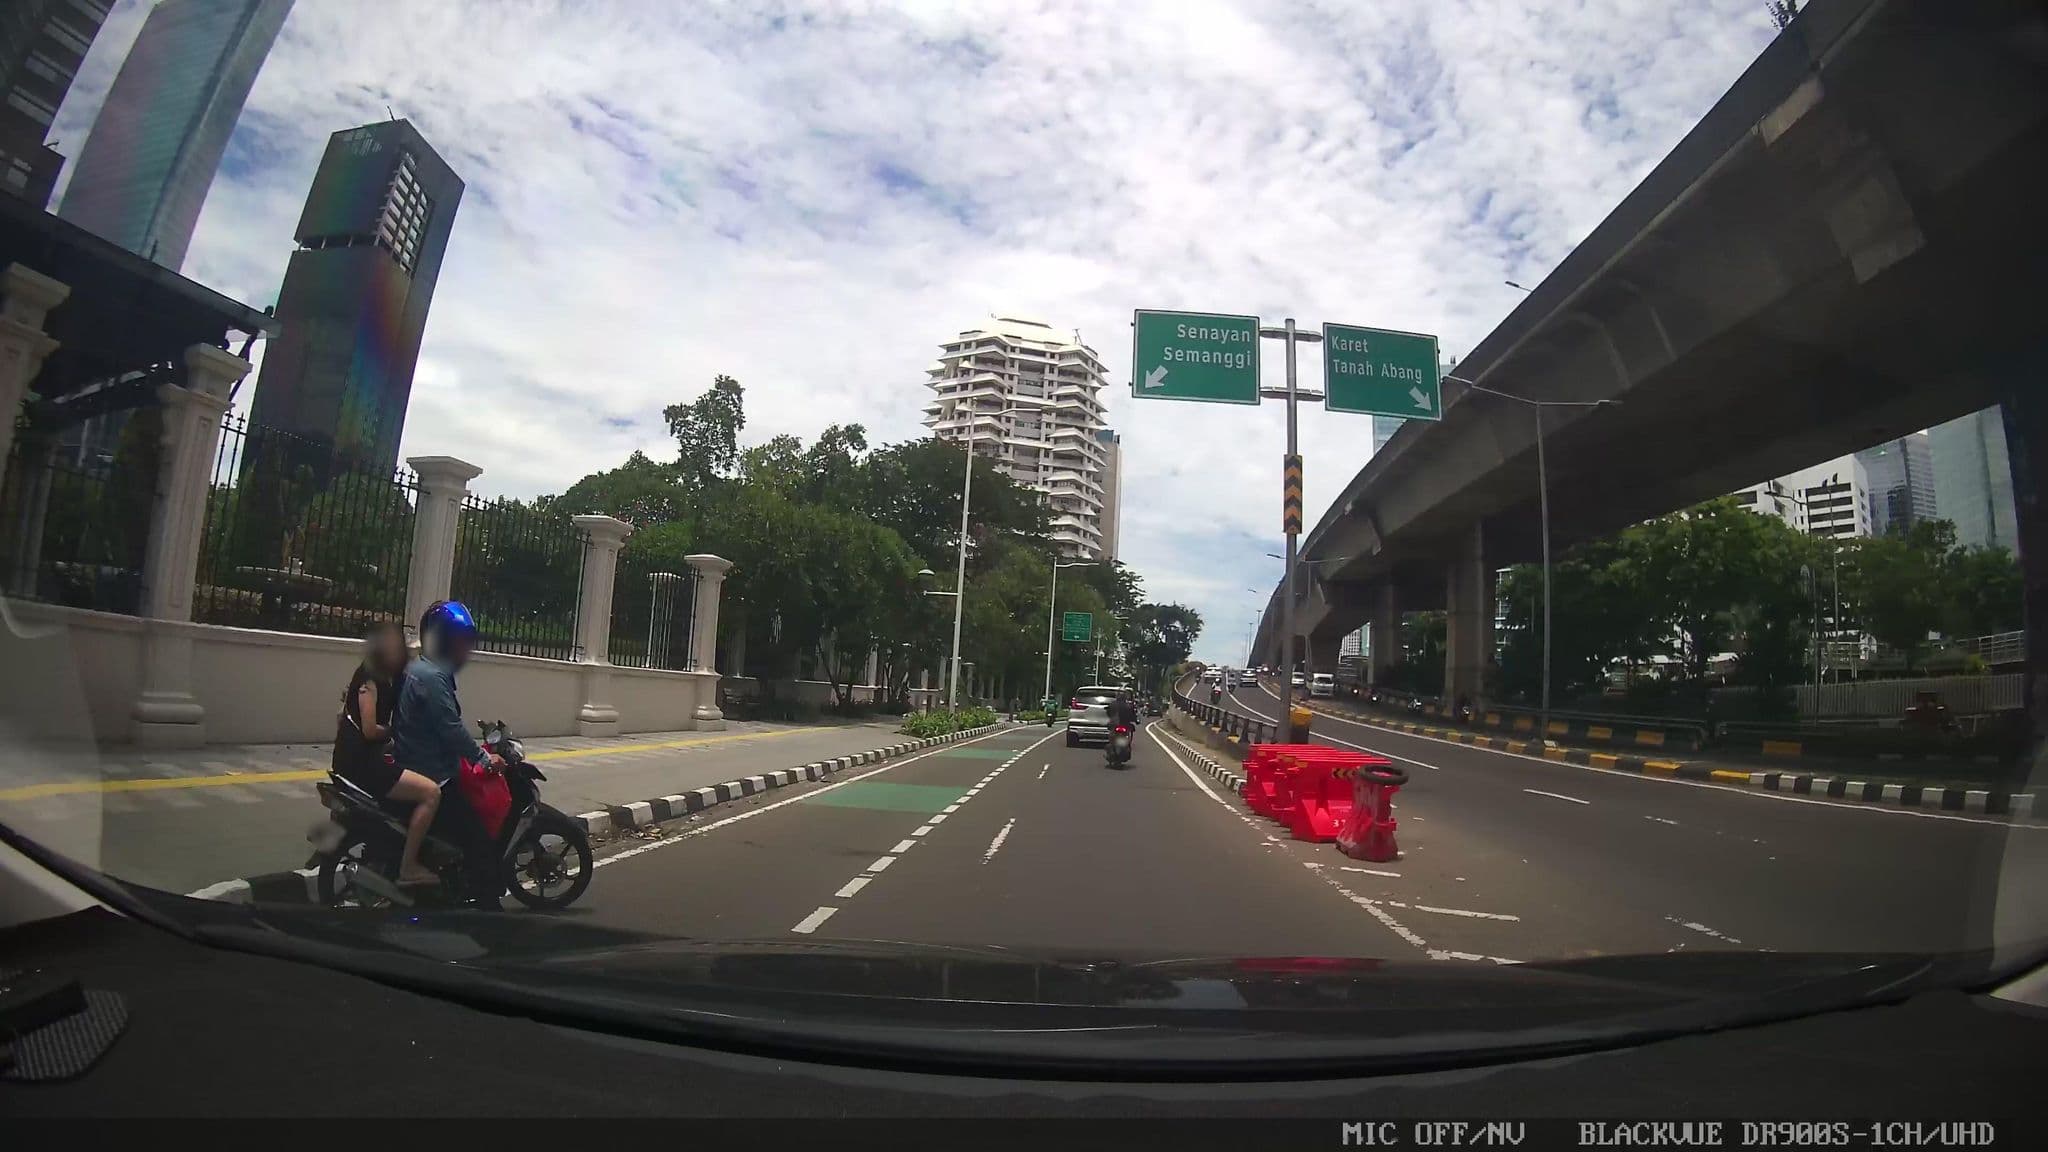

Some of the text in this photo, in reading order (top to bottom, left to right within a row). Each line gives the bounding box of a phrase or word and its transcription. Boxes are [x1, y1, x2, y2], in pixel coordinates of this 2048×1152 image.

[1177, 323, 1251, 344] Senayan
[1331, 335, 1369, 354] Karet
[1163, 346, 1252, 369] Semanggi
[1333, 358, 1423, 384] Tanah Abang
